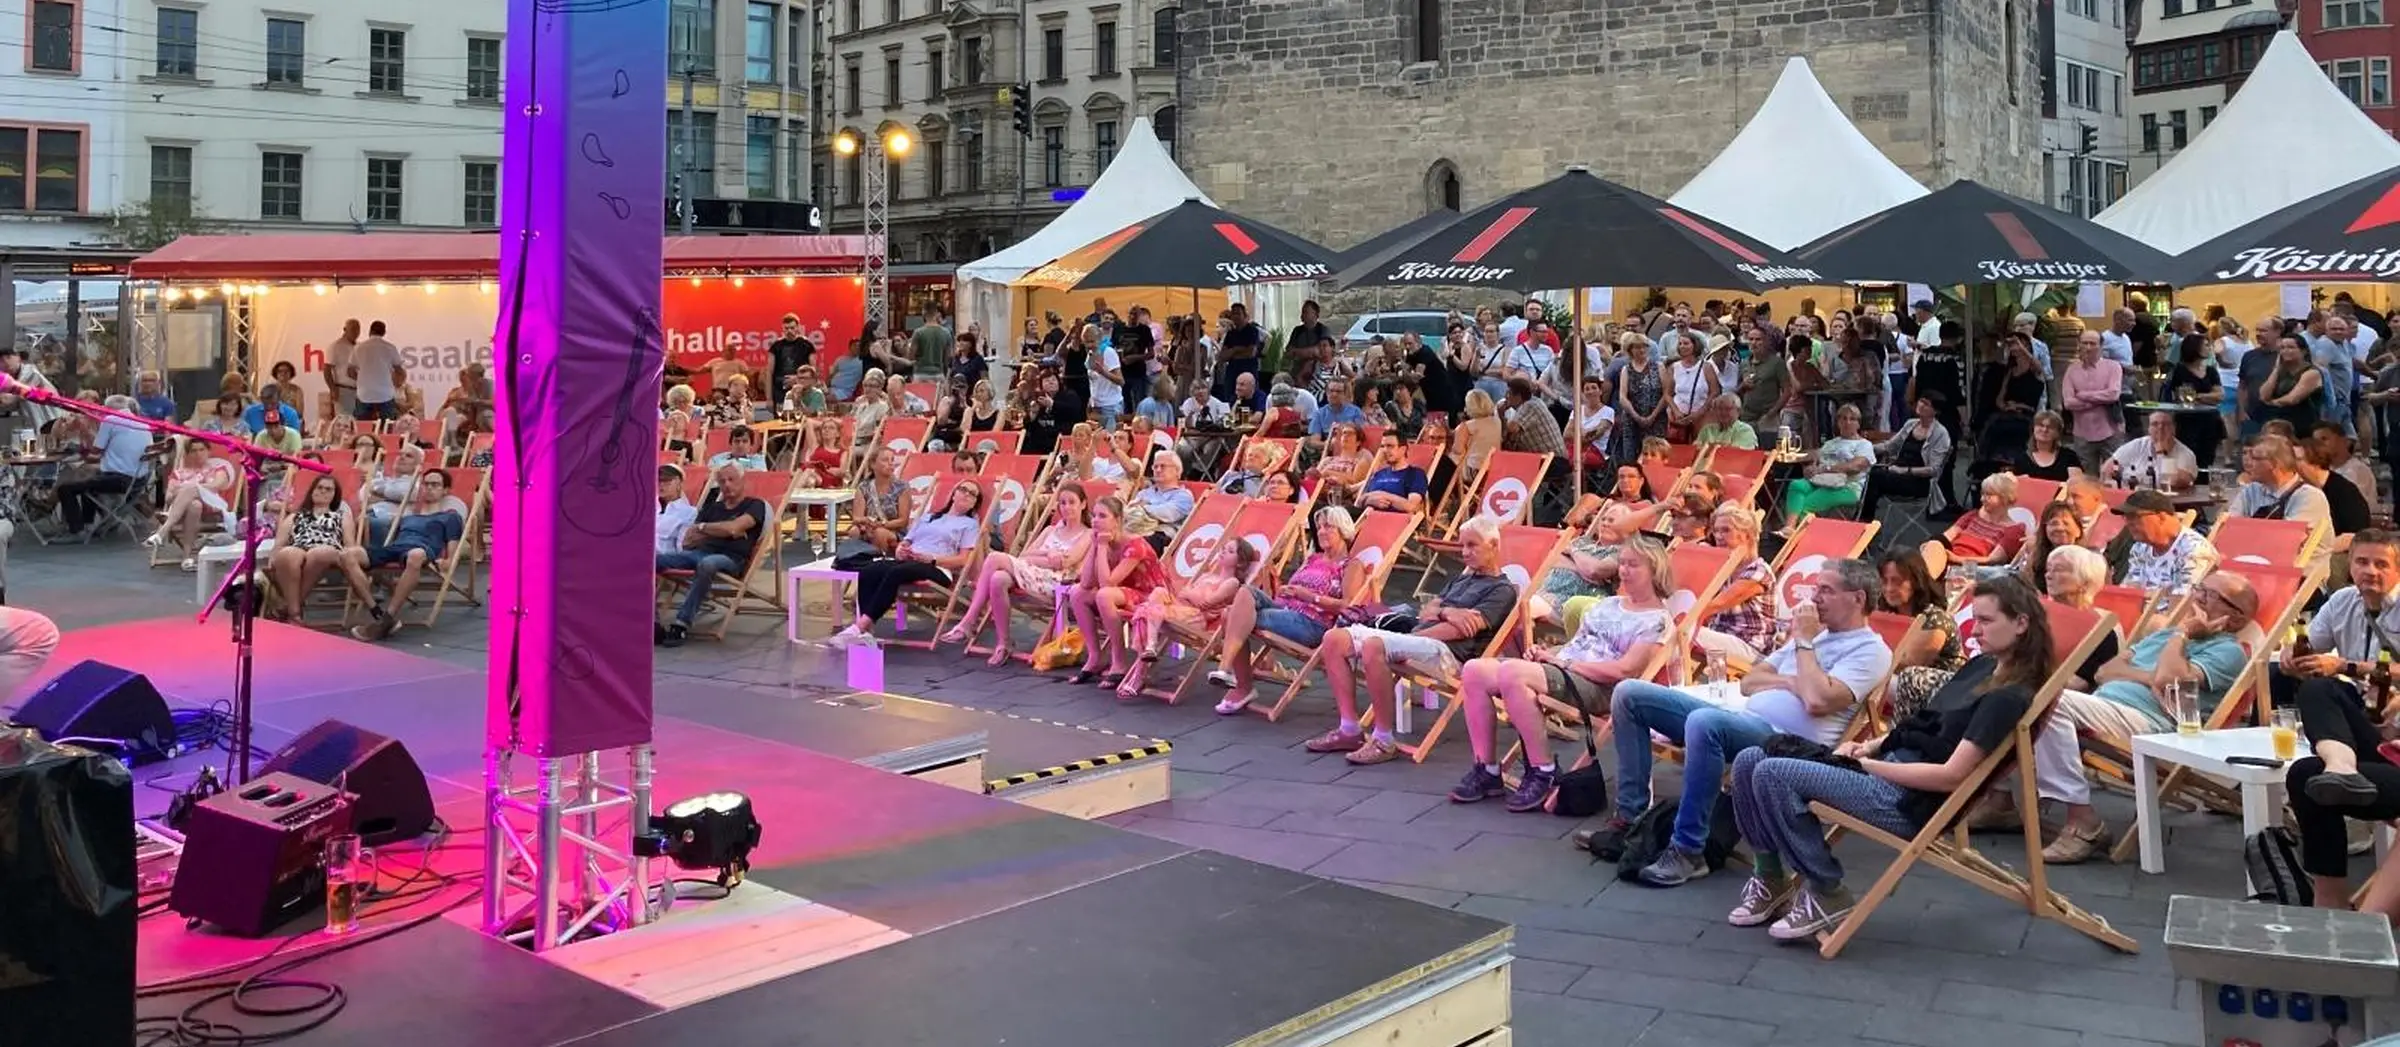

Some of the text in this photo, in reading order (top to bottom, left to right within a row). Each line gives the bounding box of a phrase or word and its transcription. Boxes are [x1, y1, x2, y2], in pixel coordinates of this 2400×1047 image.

[1216, 262, 1329, 282] Köstritzer
[1388, 262, 1514, 282] Köstritzer
[1978, 259, 2108, 281] Köstritzer
[667, 325, 825, 353] hallesae
